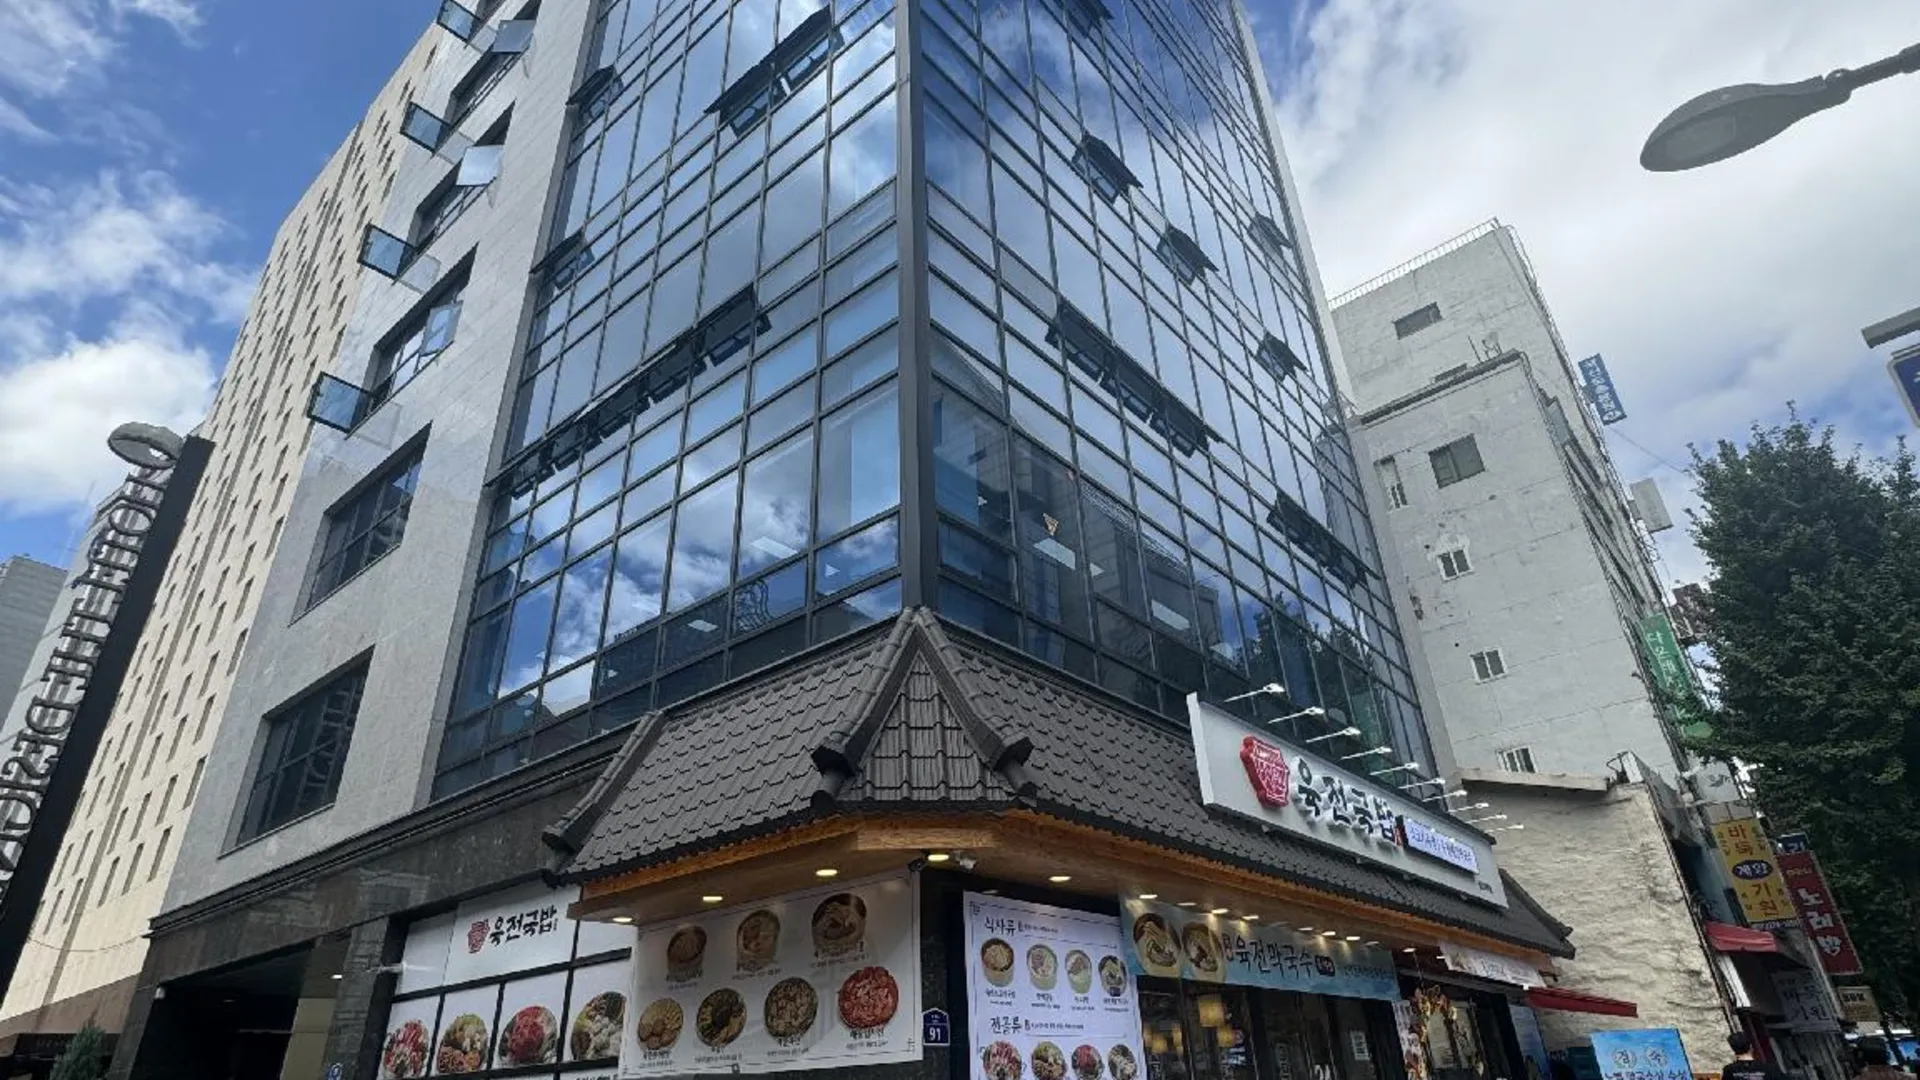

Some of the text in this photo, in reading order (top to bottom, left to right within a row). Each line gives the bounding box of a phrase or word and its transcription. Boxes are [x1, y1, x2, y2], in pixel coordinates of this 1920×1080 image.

[1297, 757, 1395, 842] 육전국밥
[488, 904, 557, 947] 육전국밥
[928, 1026, 942, 1042] 91
